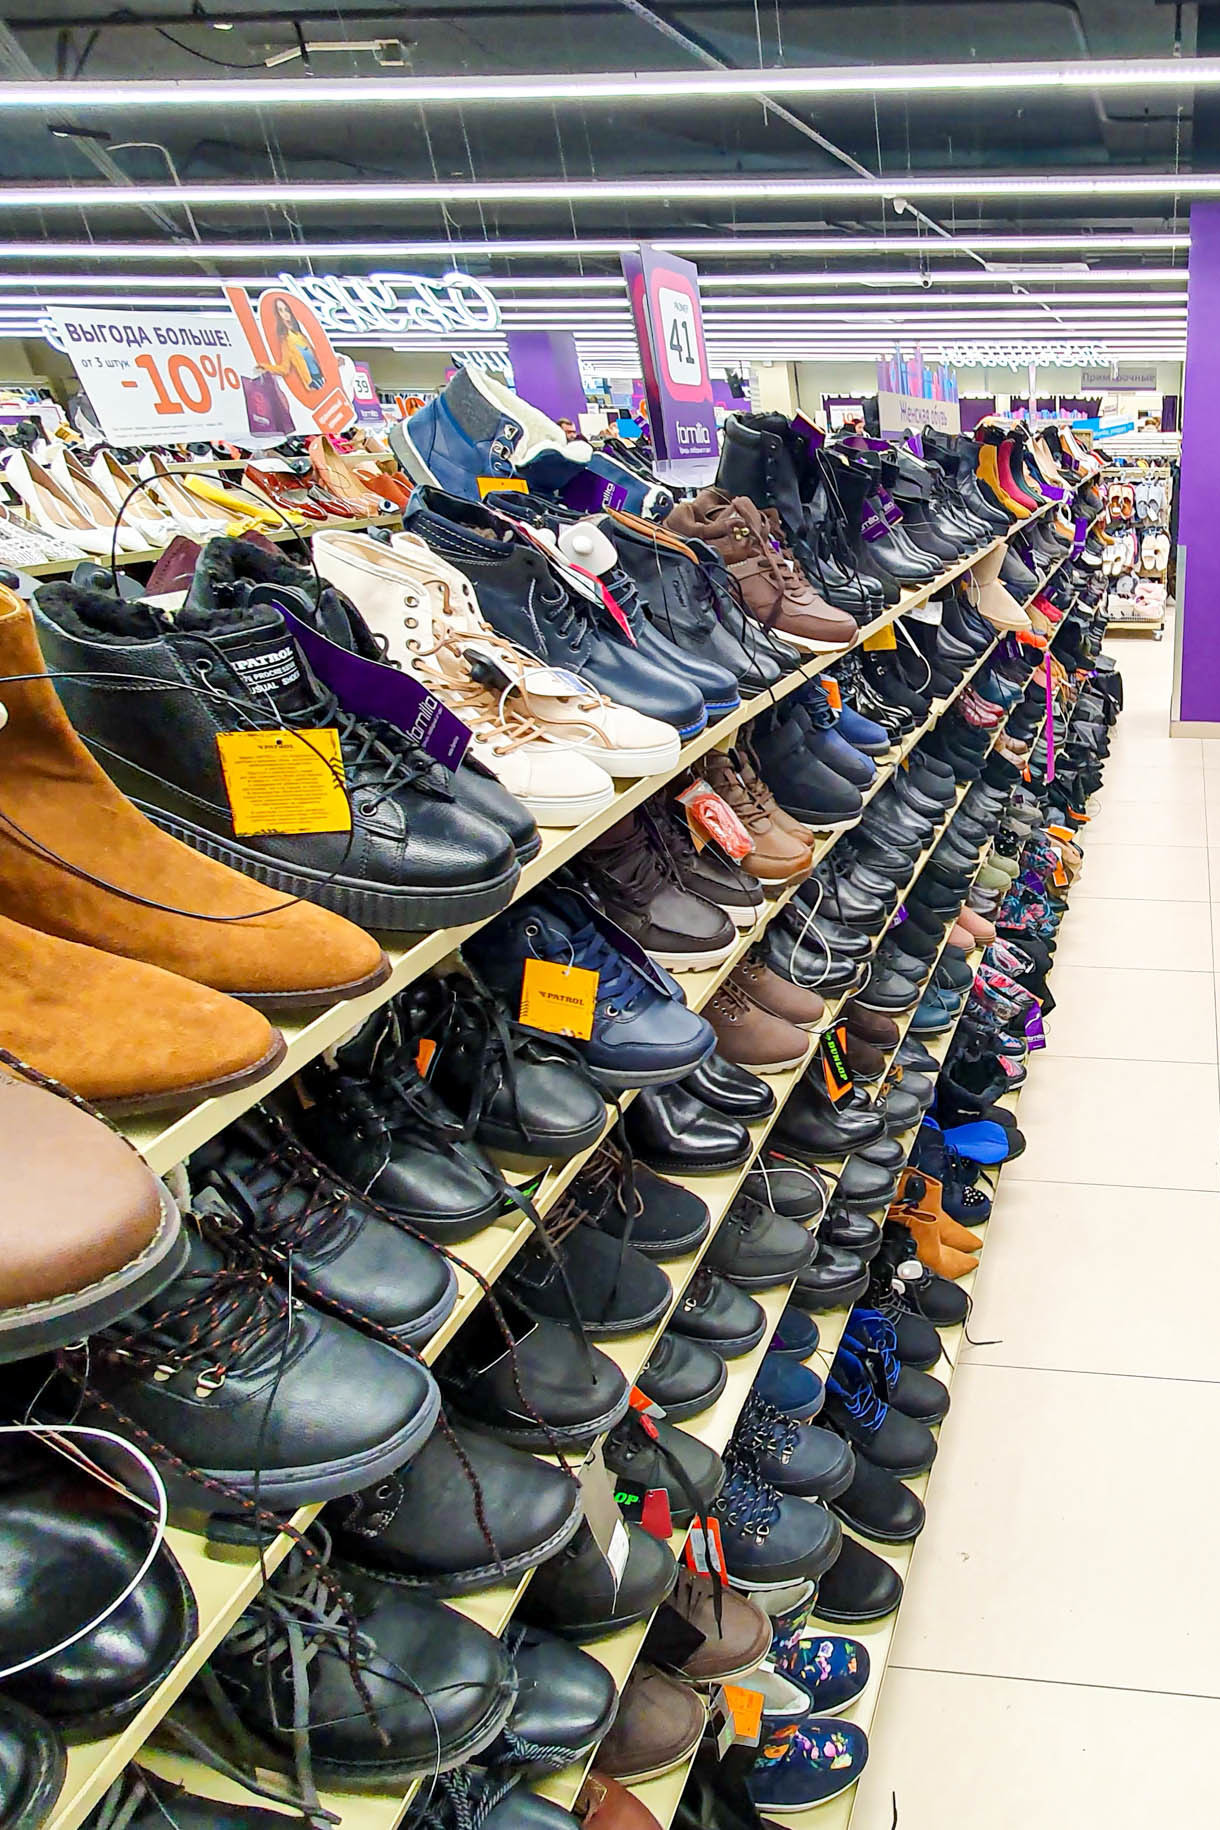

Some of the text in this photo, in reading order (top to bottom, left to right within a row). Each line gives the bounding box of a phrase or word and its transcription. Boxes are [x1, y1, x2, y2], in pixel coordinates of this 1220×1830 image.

[64, 322, 233, 348] ВЫГОДА БОЛЬШЕ!
[670, 318, 695, 364] 41
[81, 356, 130, 370] от 3 штук
[121, 353, 241, 414] -10%
[355, 379, 369, 393] 39
[1082, 372, 1156, 382] Примрочные
[547, 992, 585, 1006] PATROL
[827, 1040, 849, 1081] DUNLOP
